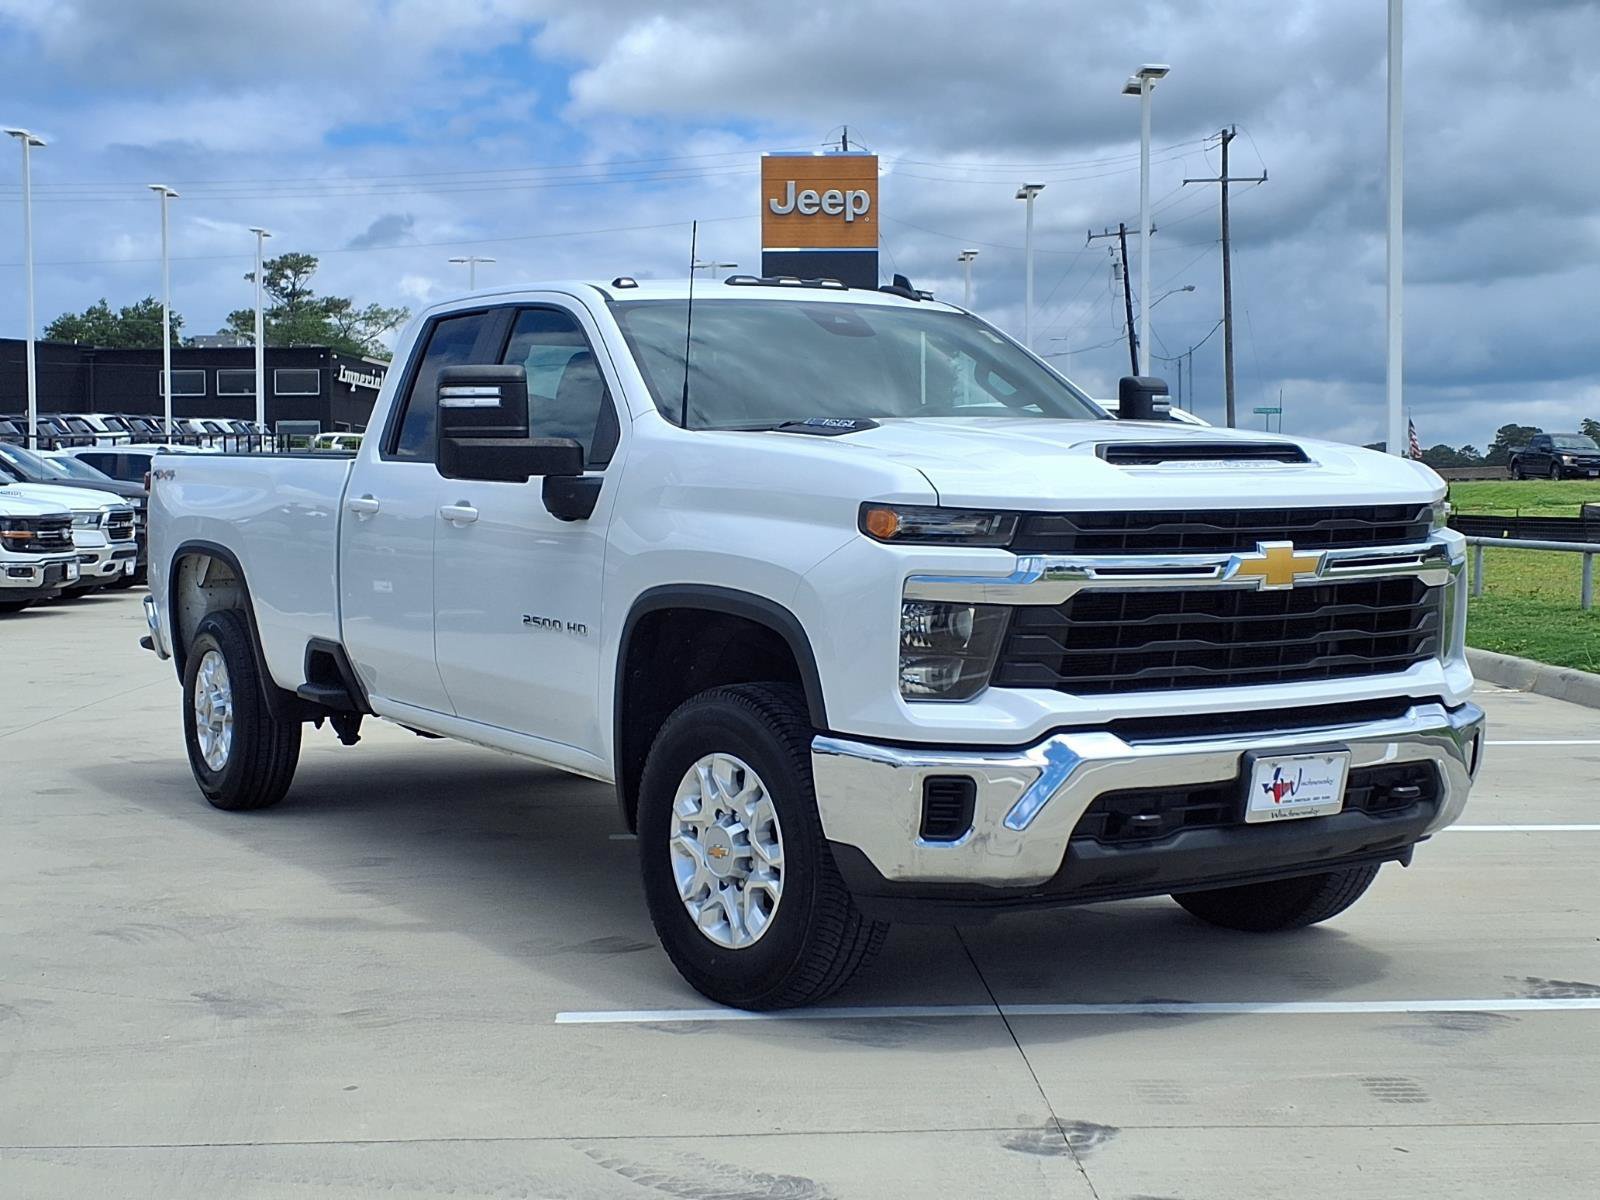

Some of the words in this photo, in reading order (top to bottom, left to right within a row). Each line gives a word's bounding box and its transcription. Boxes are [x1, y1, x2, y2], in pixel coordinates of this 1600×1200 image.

[769, 180, 871, 222] Jeep
[338, 364, 385, 392] Imperial
[522, 613, 562, 630] 2500
[566, 621, 588, 635] HD
